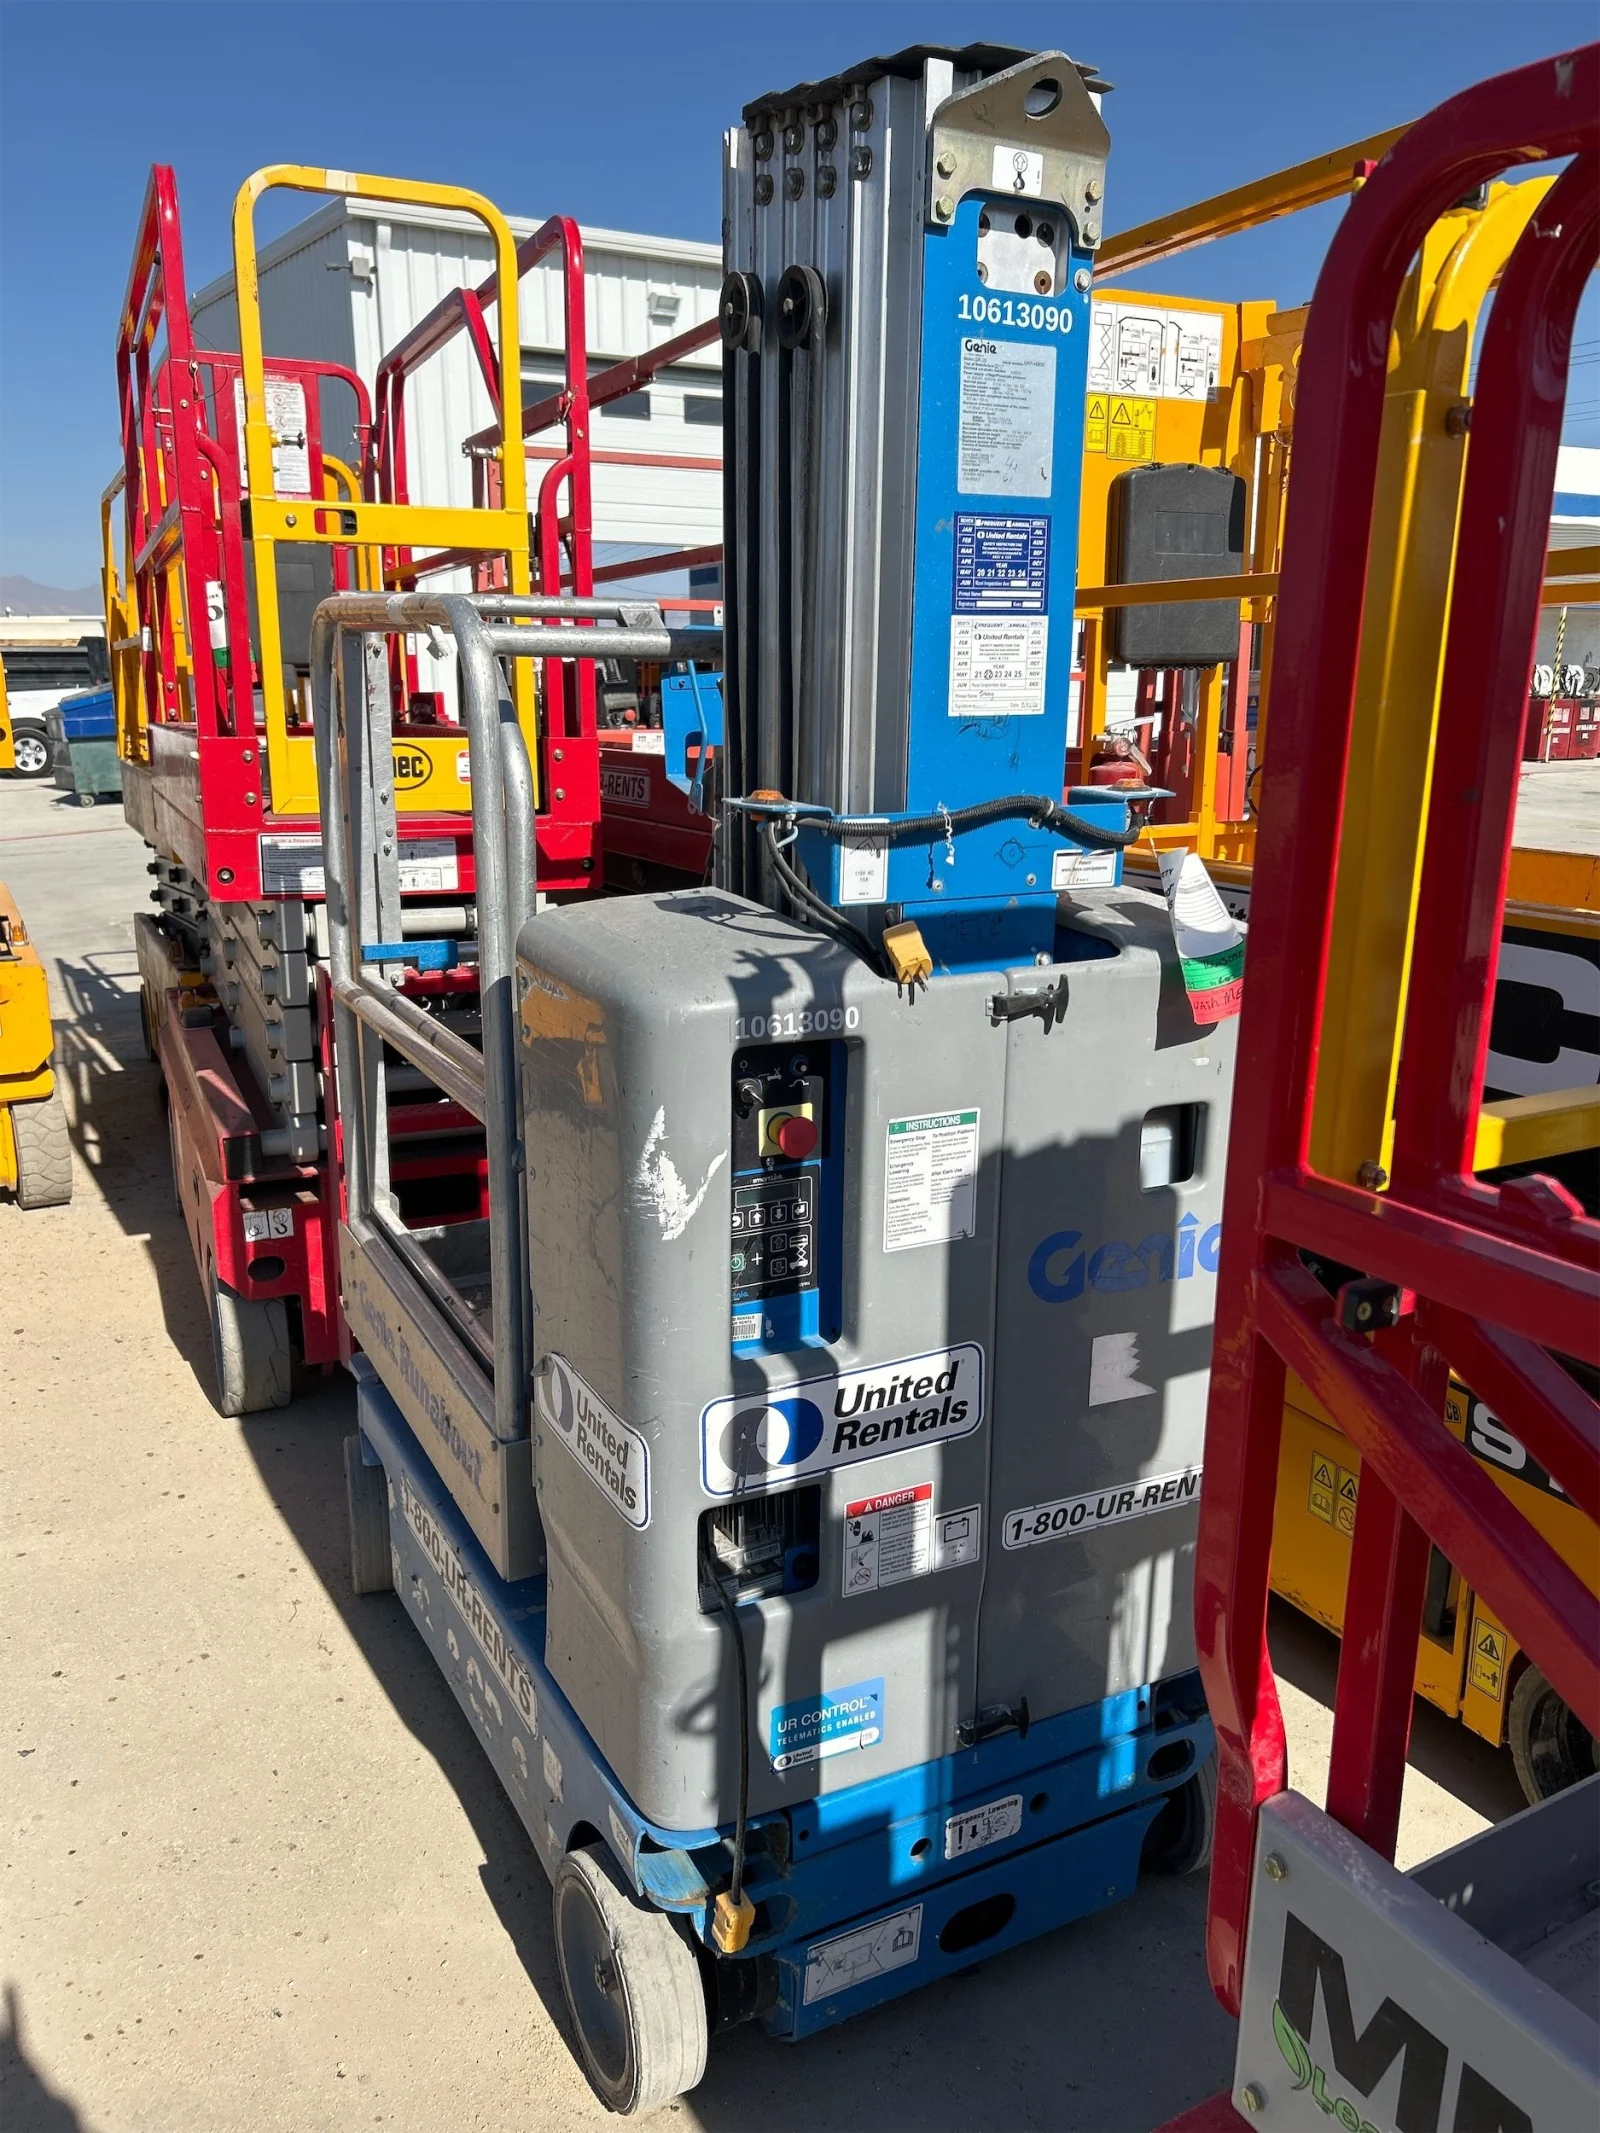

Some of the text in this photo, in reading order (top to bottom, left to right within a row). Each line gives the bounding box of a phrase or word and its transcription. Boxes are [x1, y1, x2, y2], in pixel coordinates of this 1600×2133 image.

[957, 293, 1073, 334] 10613090
[965, 339, 997, 354] Genie
[985, 531, 1028, 540] United Rentals
[976, 568, 1026, 578] 20 21 22 23 24
[1003, 633, 1025, 641] Rentals
[1014, 670, 1022, 678] 25
[735, 1006, 860, 1040] 10613090
[906, 1116, 961, 1132] INSTRUCTIONS
[889, 1168, 910, 1176] Lowering
[834, 1360, 959, 1418] United
[576, 1388, 629, 1470] United
[832, 1395, 968, 1454] Rentals
[576, 1422, 637, 1510] Rentals
[875, 1491, 914, 1509] DANGER
[402, 1483, 532, 1716] 1-800-UR-RENTS
[777, 1718, 798, 1733] UR
[777, 1711, 876, 1746] TELEMATICS ENABLED
[792, 1749, 813, 1759] United
[792, 1754, 814, 1764] Rentals
[948, 1799, 1018, 1829] Emergency Lowering
